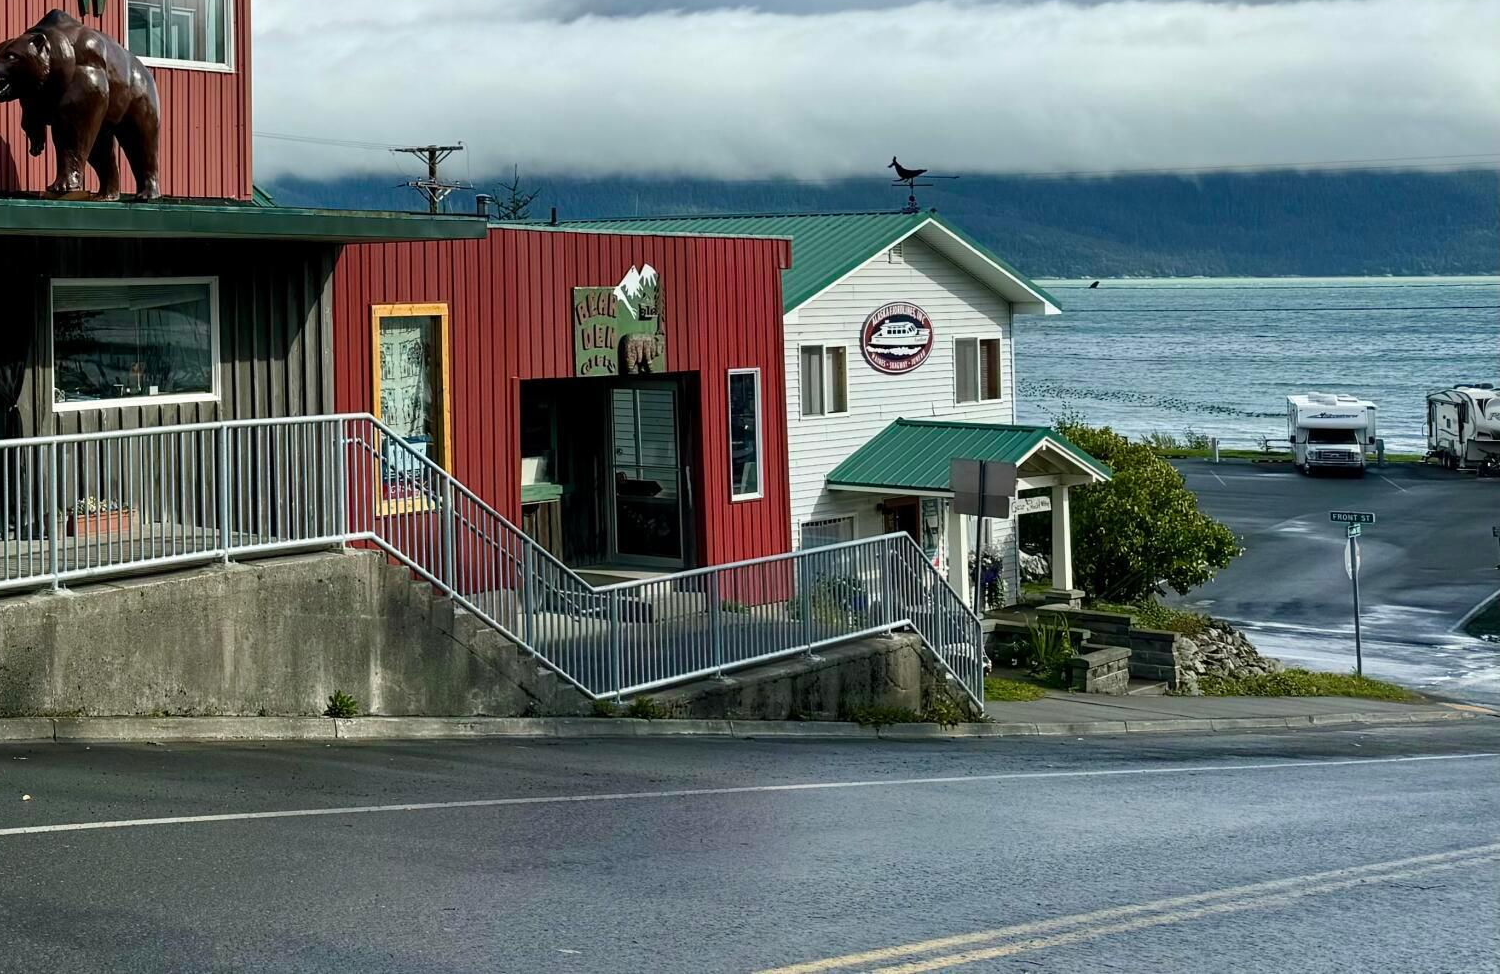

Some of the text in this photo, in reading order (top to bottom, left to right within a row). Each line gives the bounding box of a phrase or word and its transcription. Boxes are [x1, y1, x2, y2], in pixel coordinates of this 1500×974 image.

[576, 290, 618, 325] BEAR
[872, 307, 890, 327] ALASKA
[582, 324, 615, 351] DEN
[1332, 513, 1371, 522] FRONT ST
